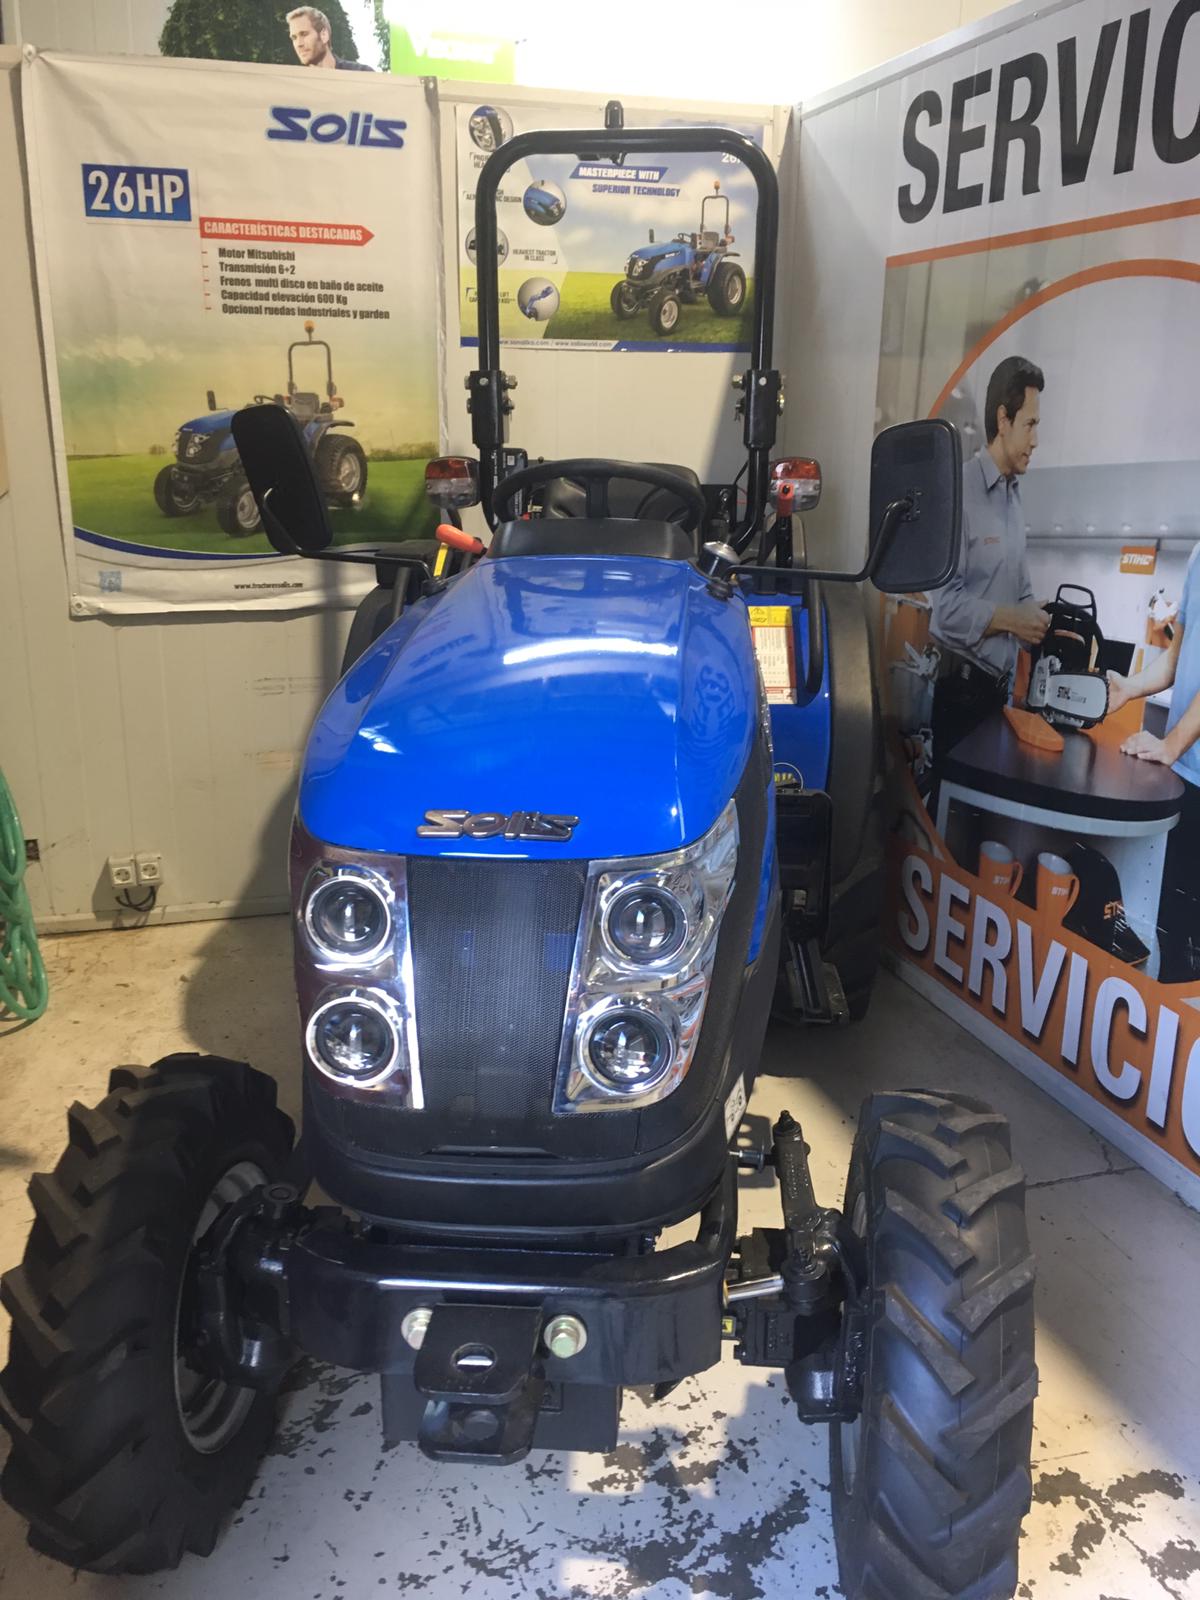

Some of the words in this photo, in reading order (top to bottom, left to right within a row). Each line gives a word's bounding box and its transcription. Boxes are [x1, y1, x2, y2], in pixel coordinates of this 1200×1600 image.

[267, 106, 408, 149] Solis
[579, 167, 637, 180] MASTERPIECE
[638, 170, 660, 181] WITH
[88, 170, 185, 214] 26HP
[592, 184, 631, 195] SUPERIOR
[633, 185, 681, 197] TECHNOLOGY
[204, 221, 298, 238] CARACTERÍSTICAS
[299, 226, 363, 241] DESTACADAS
[218, 248, 246, 259] Motor
[247, 249, 296, 261] Mitsubishi
[219, 261, 277, 275] Transmisión
[278, 265, 296, 275] 6+2
[220, 276, 252, 287] Frenos
[255, 277, 279, 288] multi
[280, 278, 305, 289] disco
[306, 281, 319, 290] en
[320, 280, 342, 291] baño
[343, 280, 355, 291] de
[356, 281, 384, 292] aceite
[221, 290, 270, 303] Capacidad
[271, 291, 316, 304] elevación
[317, 293, 335, 304] 600
[336, 294, 348, 306] Kg
[222, 303, 263, 316] Opcional
[264, 305, 296, 316] ruedas
[297, 306, 351, 319] industriales
[352, 310, 358, 320] y
[359, 309, 390, 320] garden
